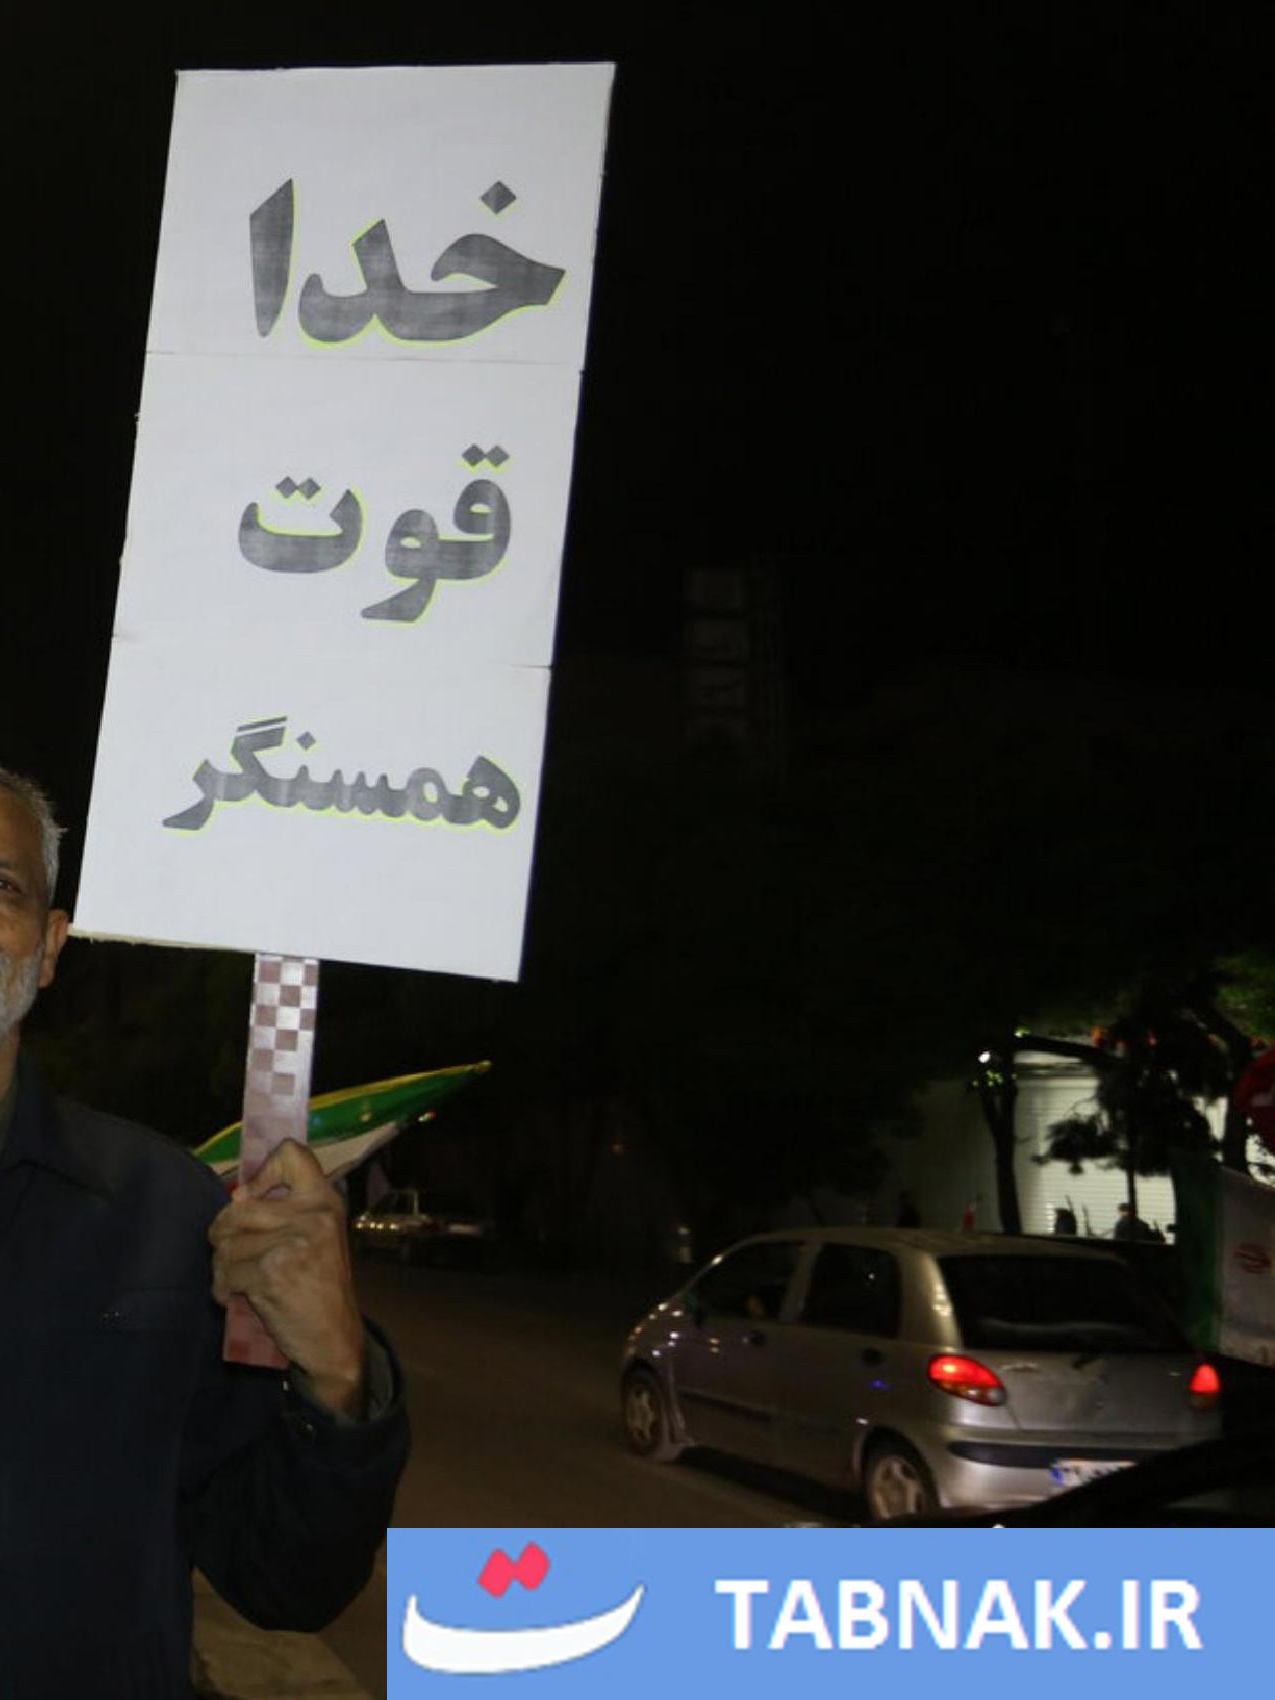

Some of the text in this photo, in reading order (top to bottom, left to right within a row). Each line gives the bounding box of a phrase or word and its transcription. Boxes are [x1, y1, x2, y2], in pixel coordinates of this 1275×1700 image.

[249, 177, 565, 347] خدا
[238, 443, 512, 623] قوت
[163, 716, 524, 832] همسنگر
